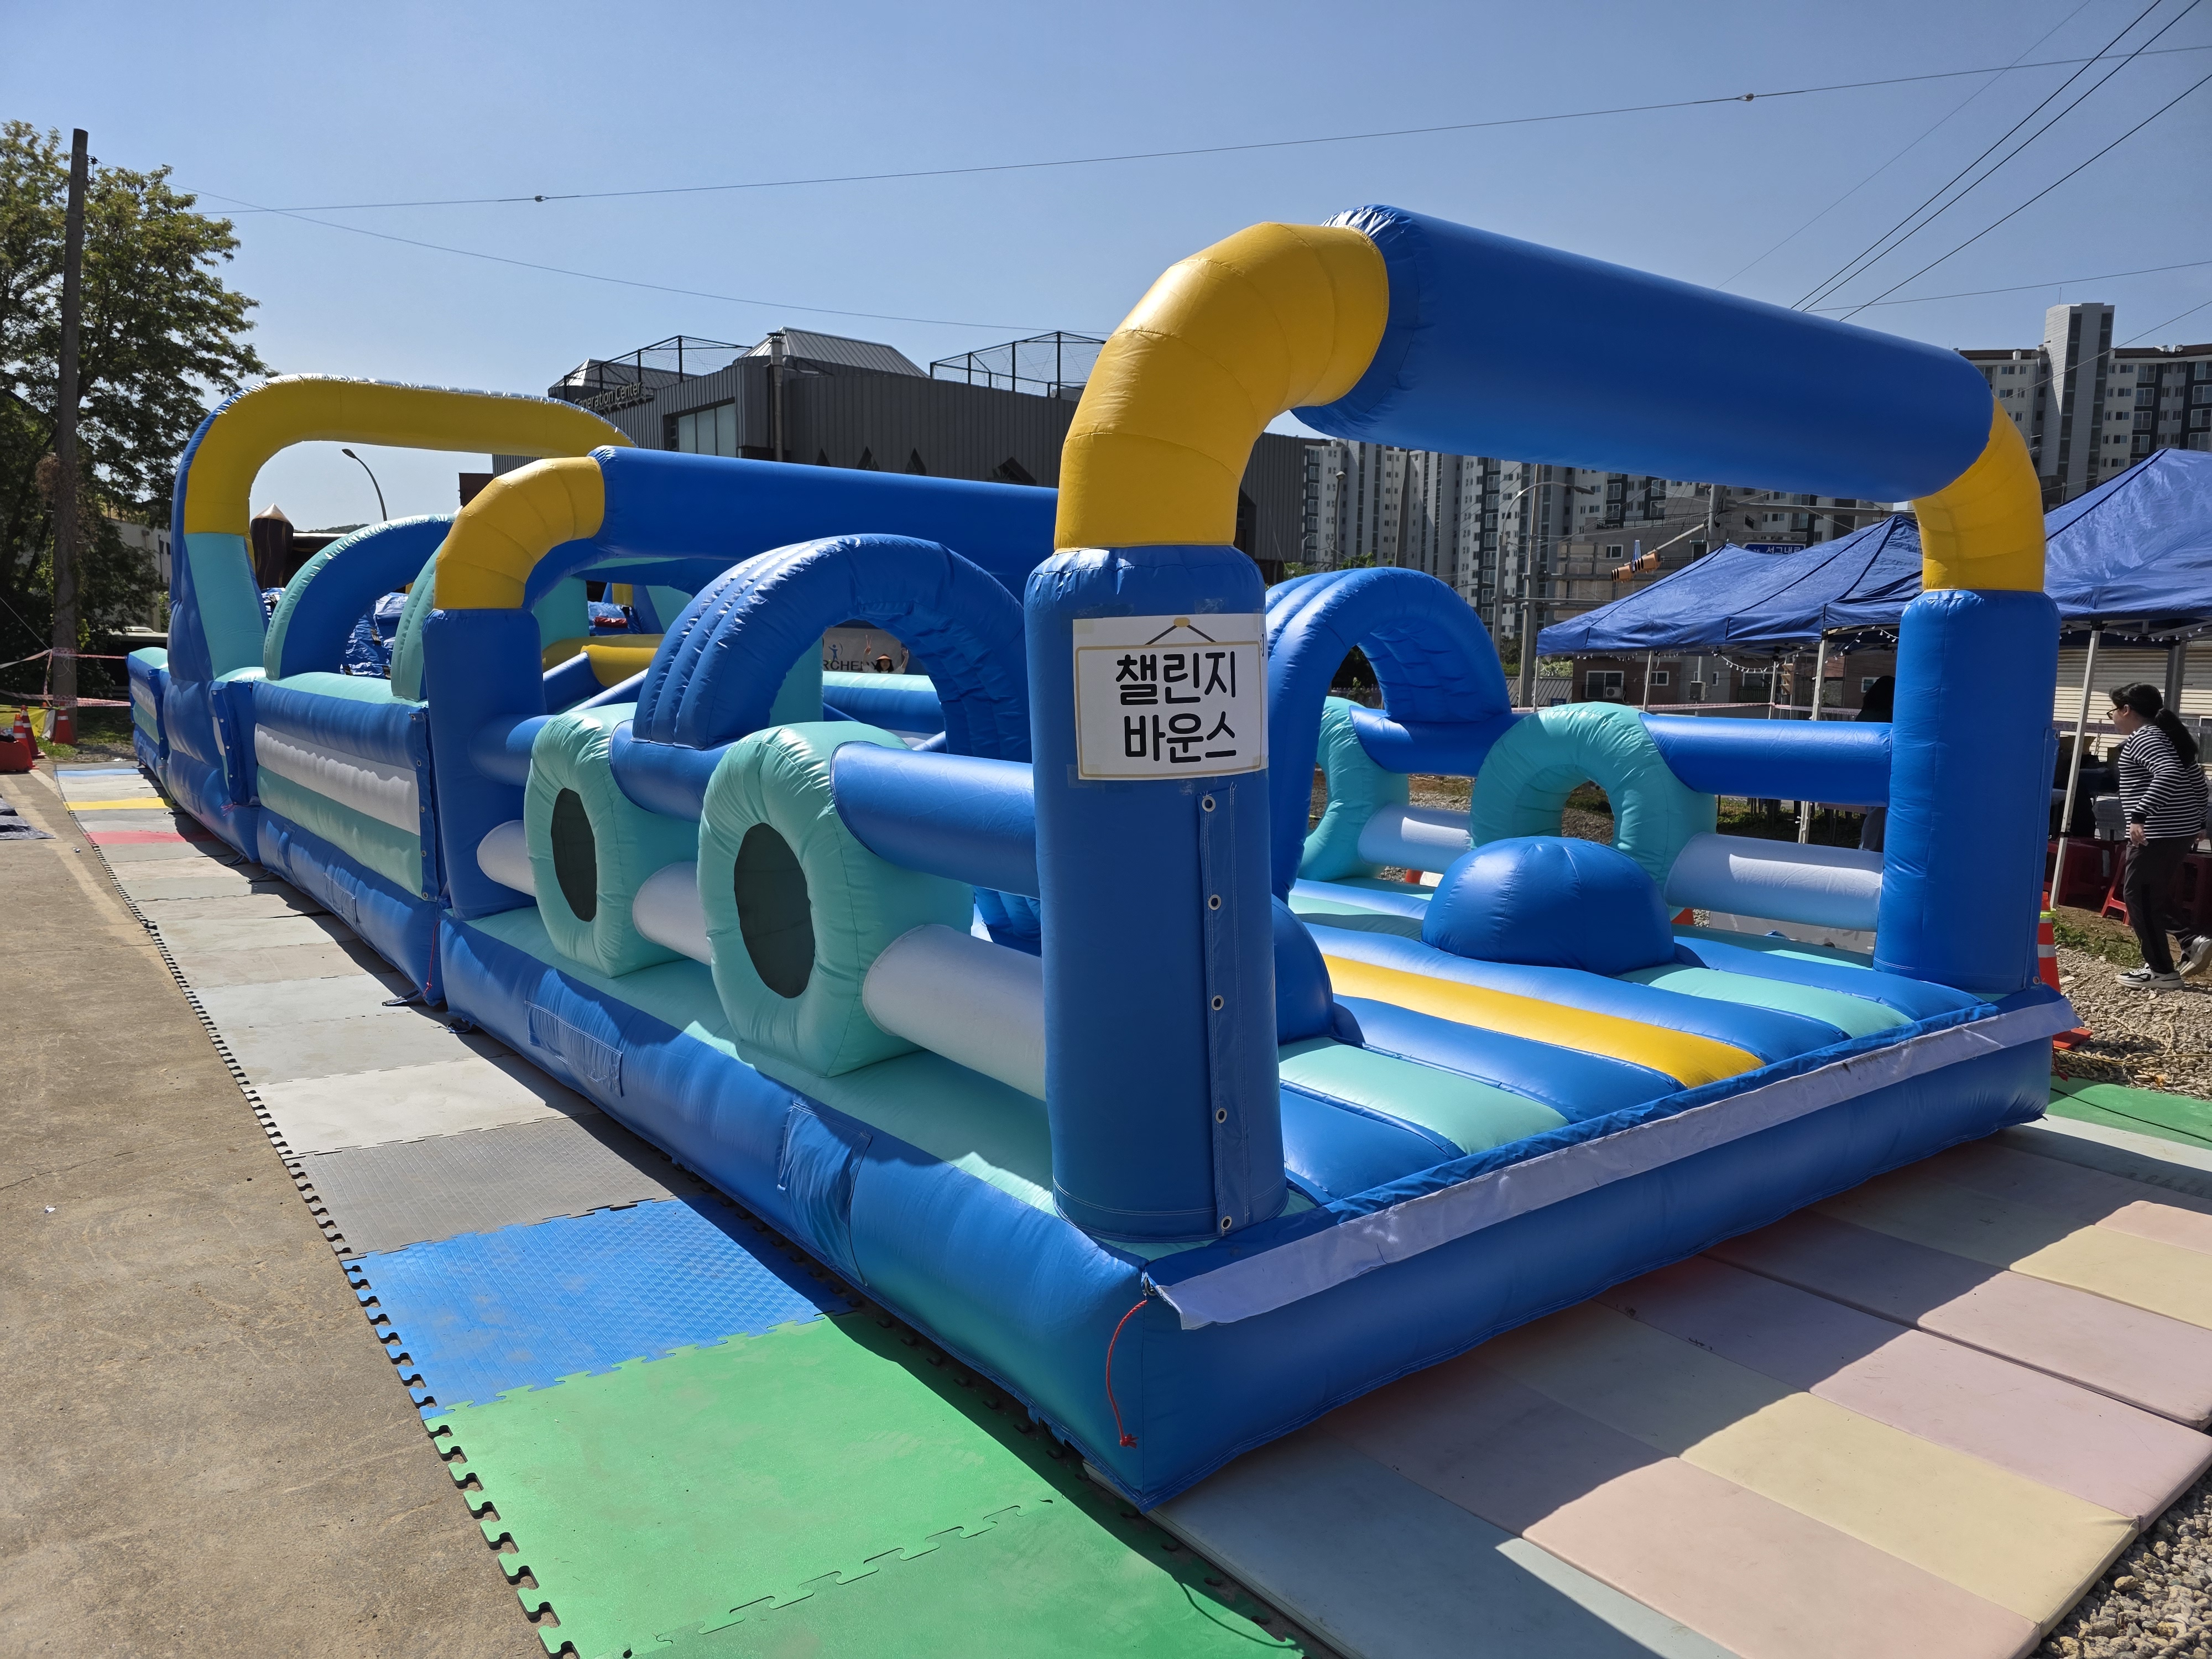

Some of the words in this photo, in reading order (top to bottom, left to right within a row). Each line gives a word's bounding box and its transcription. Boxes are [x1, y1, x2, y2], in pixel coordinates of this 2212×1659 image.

[615, 382, 641, 400] Center
[823, 660, 878, 671] RCHE
[1116, 651, 1235, 705] 챌린지
[1124, 711, 1236, 763] 바운스
